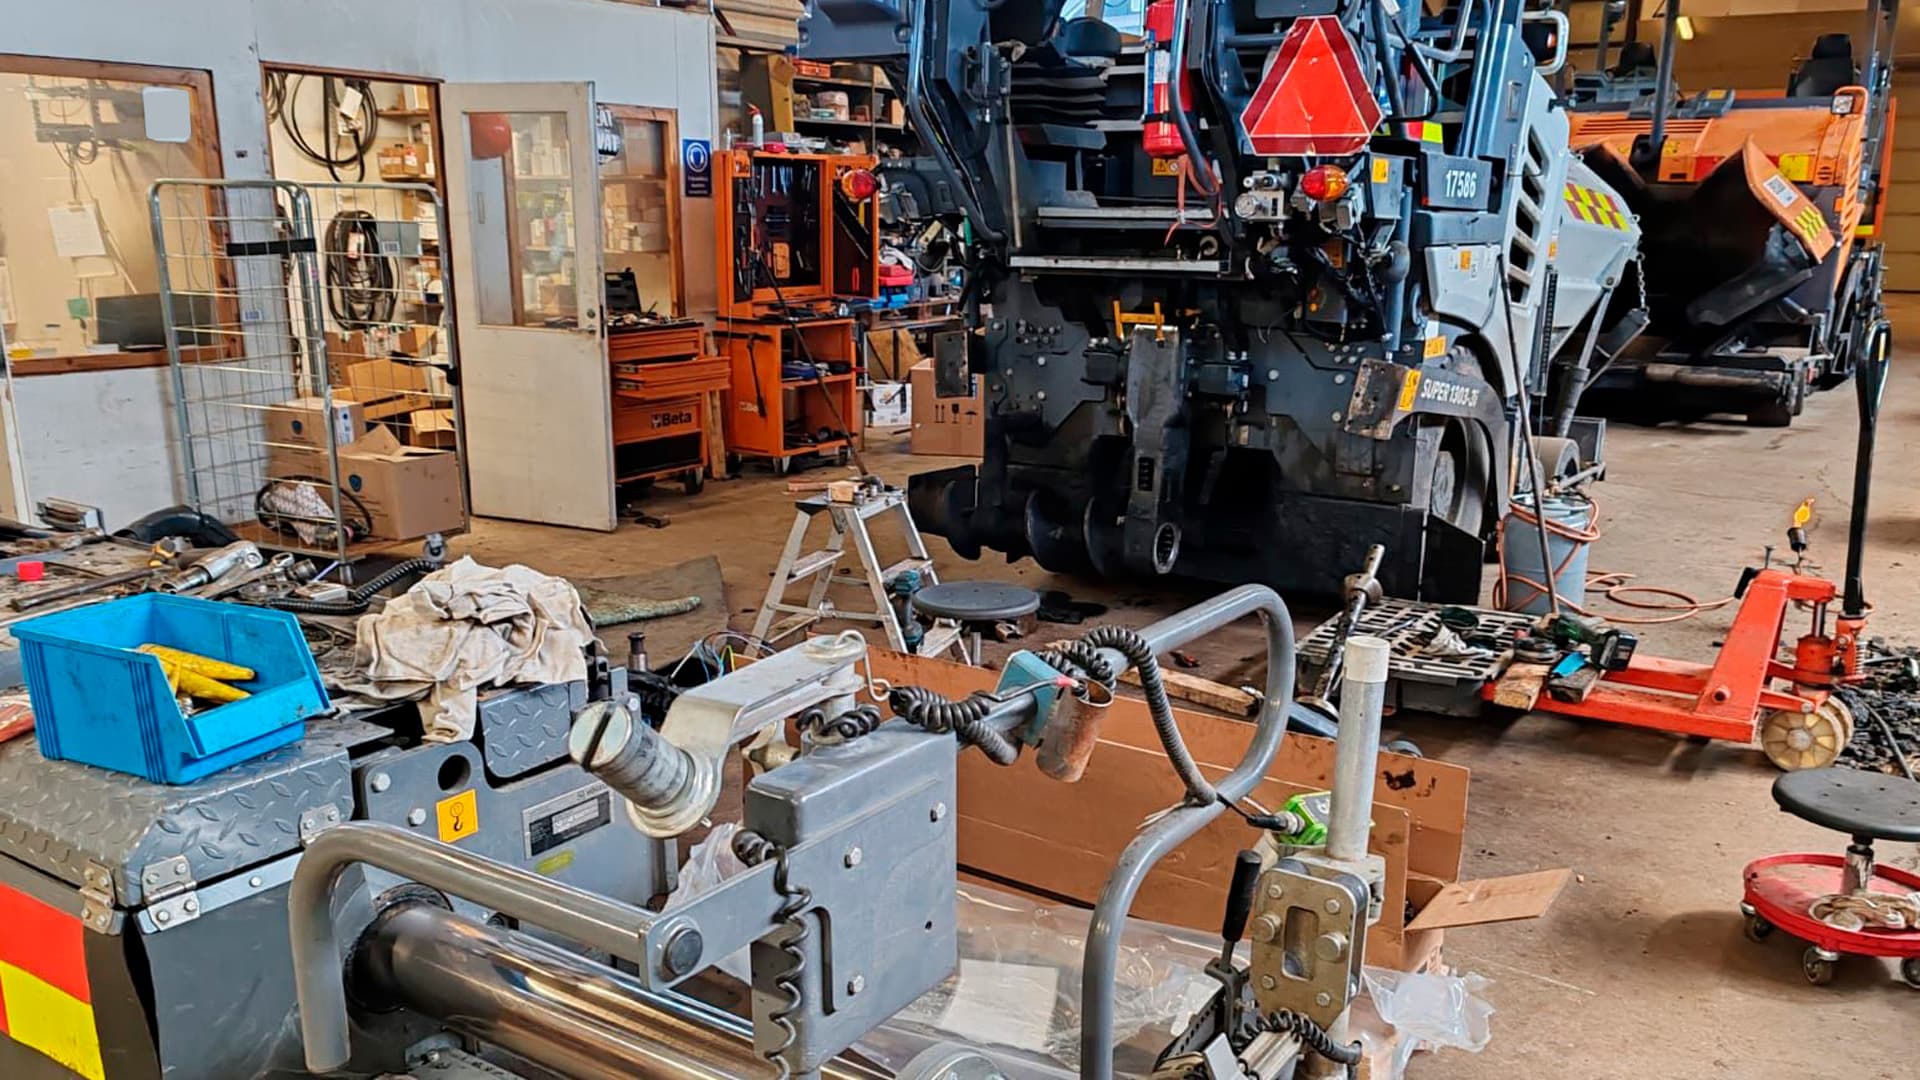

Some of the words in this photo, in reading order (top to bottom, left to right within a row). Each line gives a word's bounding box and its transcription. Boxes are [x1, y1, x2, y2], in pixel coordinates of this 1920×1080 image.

[1445, 169, 1477, 199] 17586
[1421, 378, 1450, 402] SUPER
[662, 412, 692, 427] Beta
